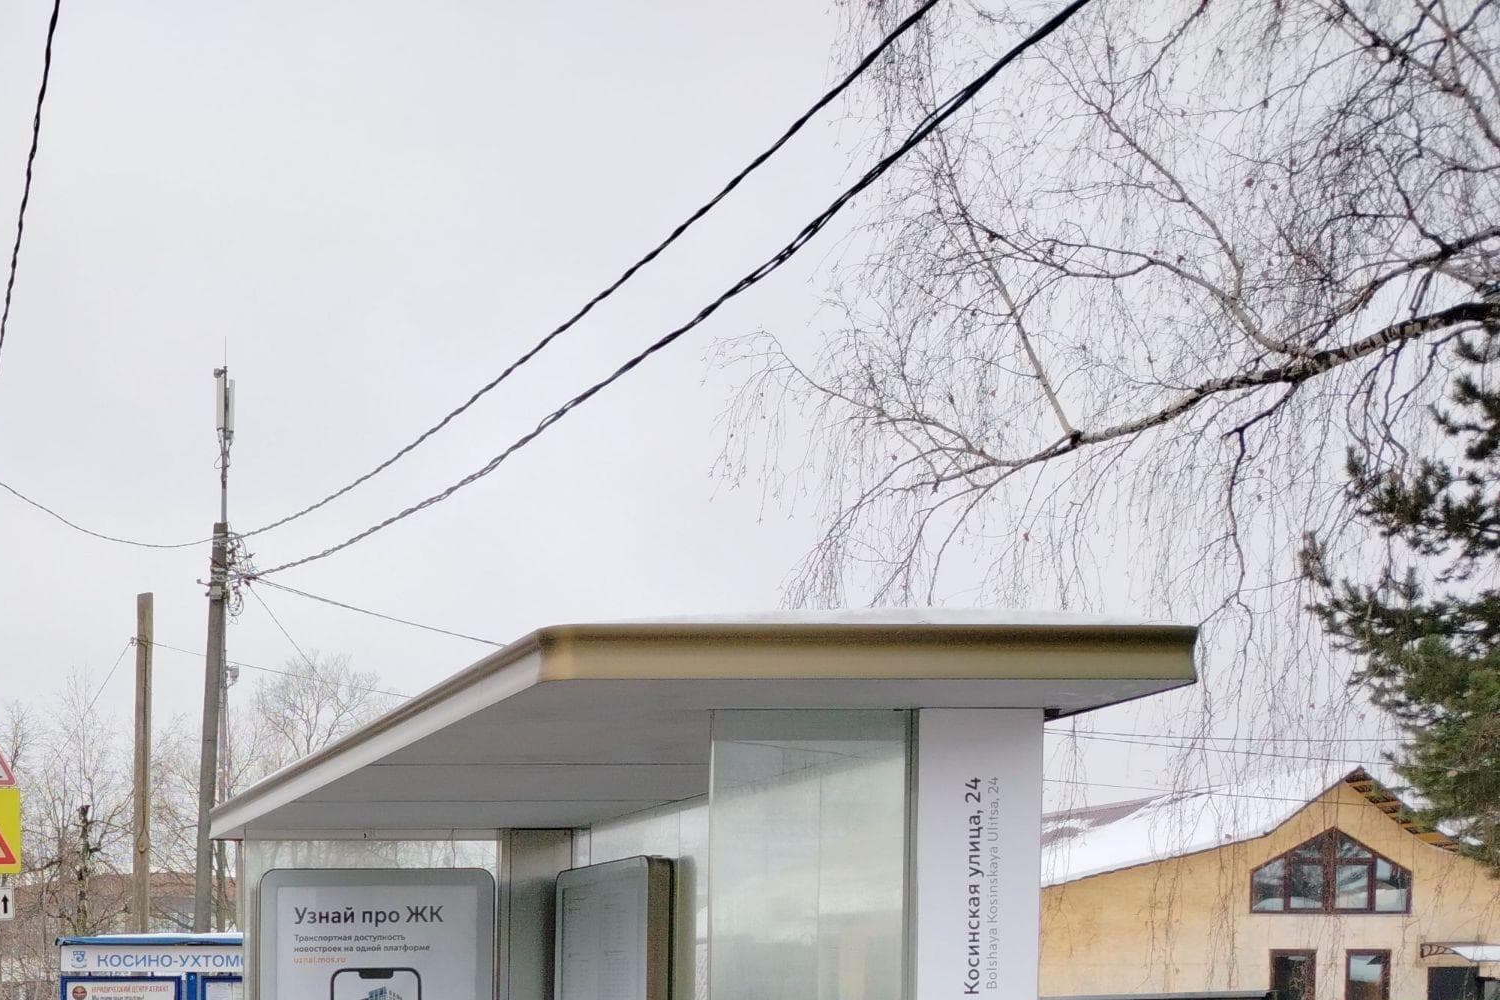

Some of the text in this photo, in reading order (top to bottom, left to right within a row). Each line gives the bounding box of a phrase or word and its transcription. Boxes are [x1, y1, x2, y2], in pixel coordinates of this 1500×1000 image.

[964, 777, 981, 803] 24
[968, 809, 985, 878] улица,
[986, 776, 1001, 990] Bolshaya Kosinskaya Ulitsa, 24
[294, 905, 444, 927] Узнай про ЖК
[294, 934, 406, 942] Транспортная доступность
[355, 944, 381, 953] одной
[383, 944, 430, 953] платформе
[963, 884, 980, 995] Косинская
